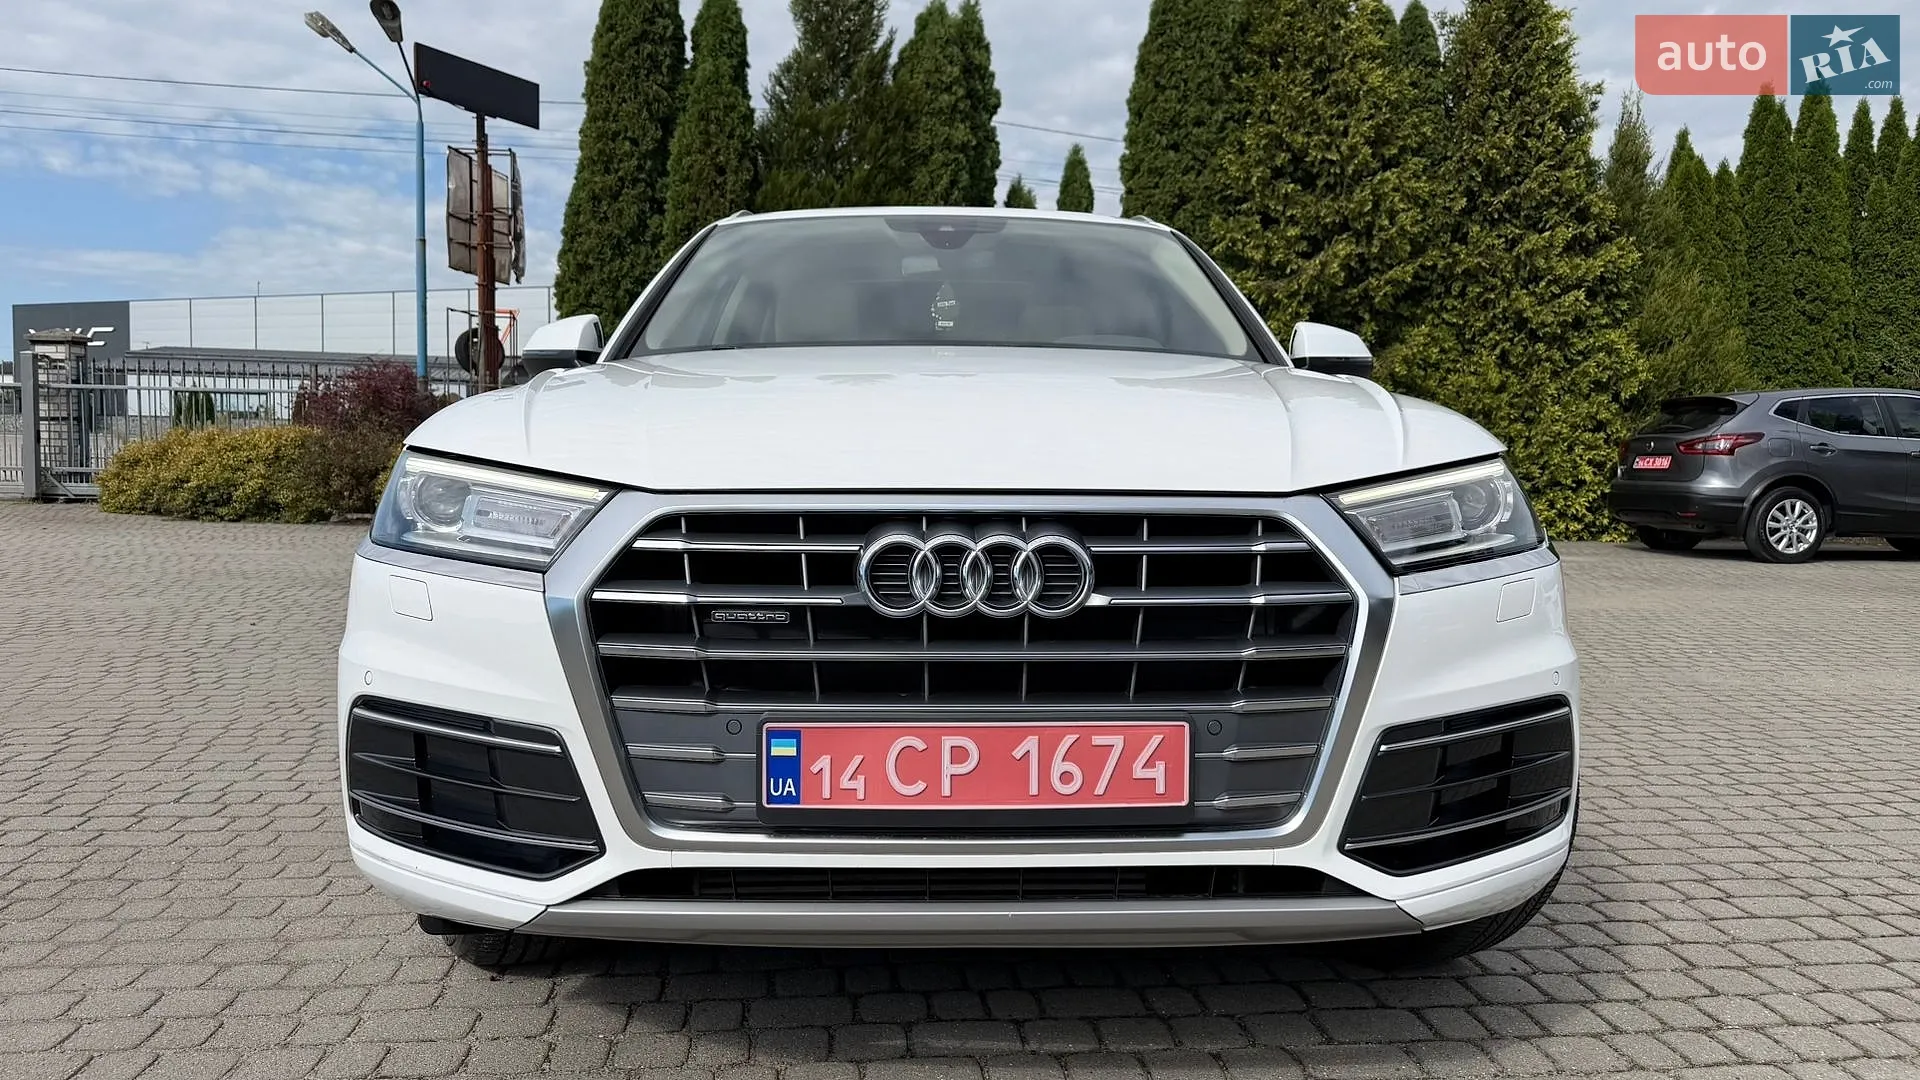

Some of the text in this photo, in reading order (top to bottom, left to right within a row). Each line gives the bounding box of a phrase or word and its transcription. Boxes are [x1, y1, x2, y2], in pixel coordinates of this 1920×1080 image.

[714, 612, 786, 621] quattro
[810, 734, 1167, 800] 14 CP 1674
[770, 777, 797, 796] UA
